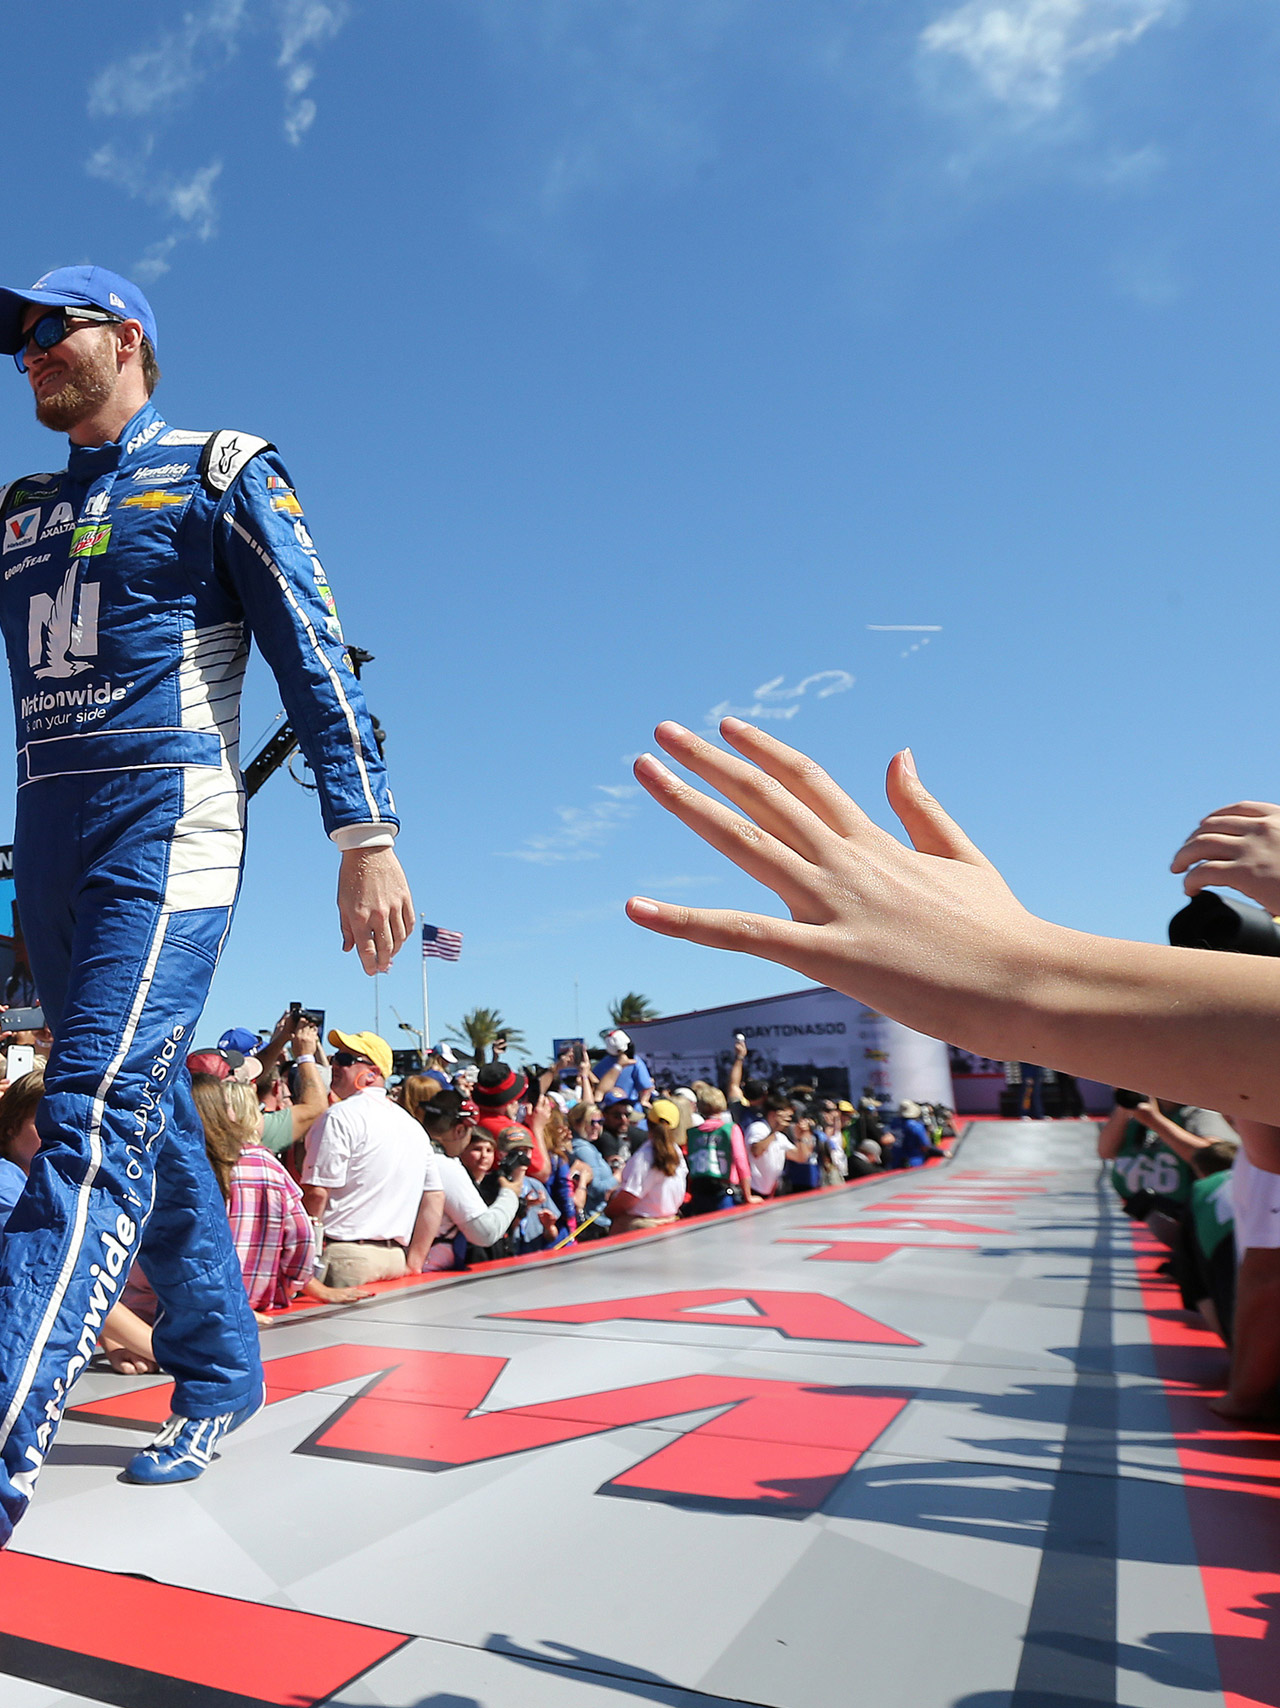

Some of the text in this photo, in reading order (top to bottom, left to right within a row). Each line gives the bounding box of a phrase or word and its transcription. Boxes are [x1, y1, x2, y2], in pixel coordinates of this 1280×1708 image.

[39, 522, 77, 541] AXALTA
[21, 682, 127, 719] Nationwide
[45, 712, 72, 730] your
[75, 708, 107, 723] side
[151, 1025, 186, 1082] side
